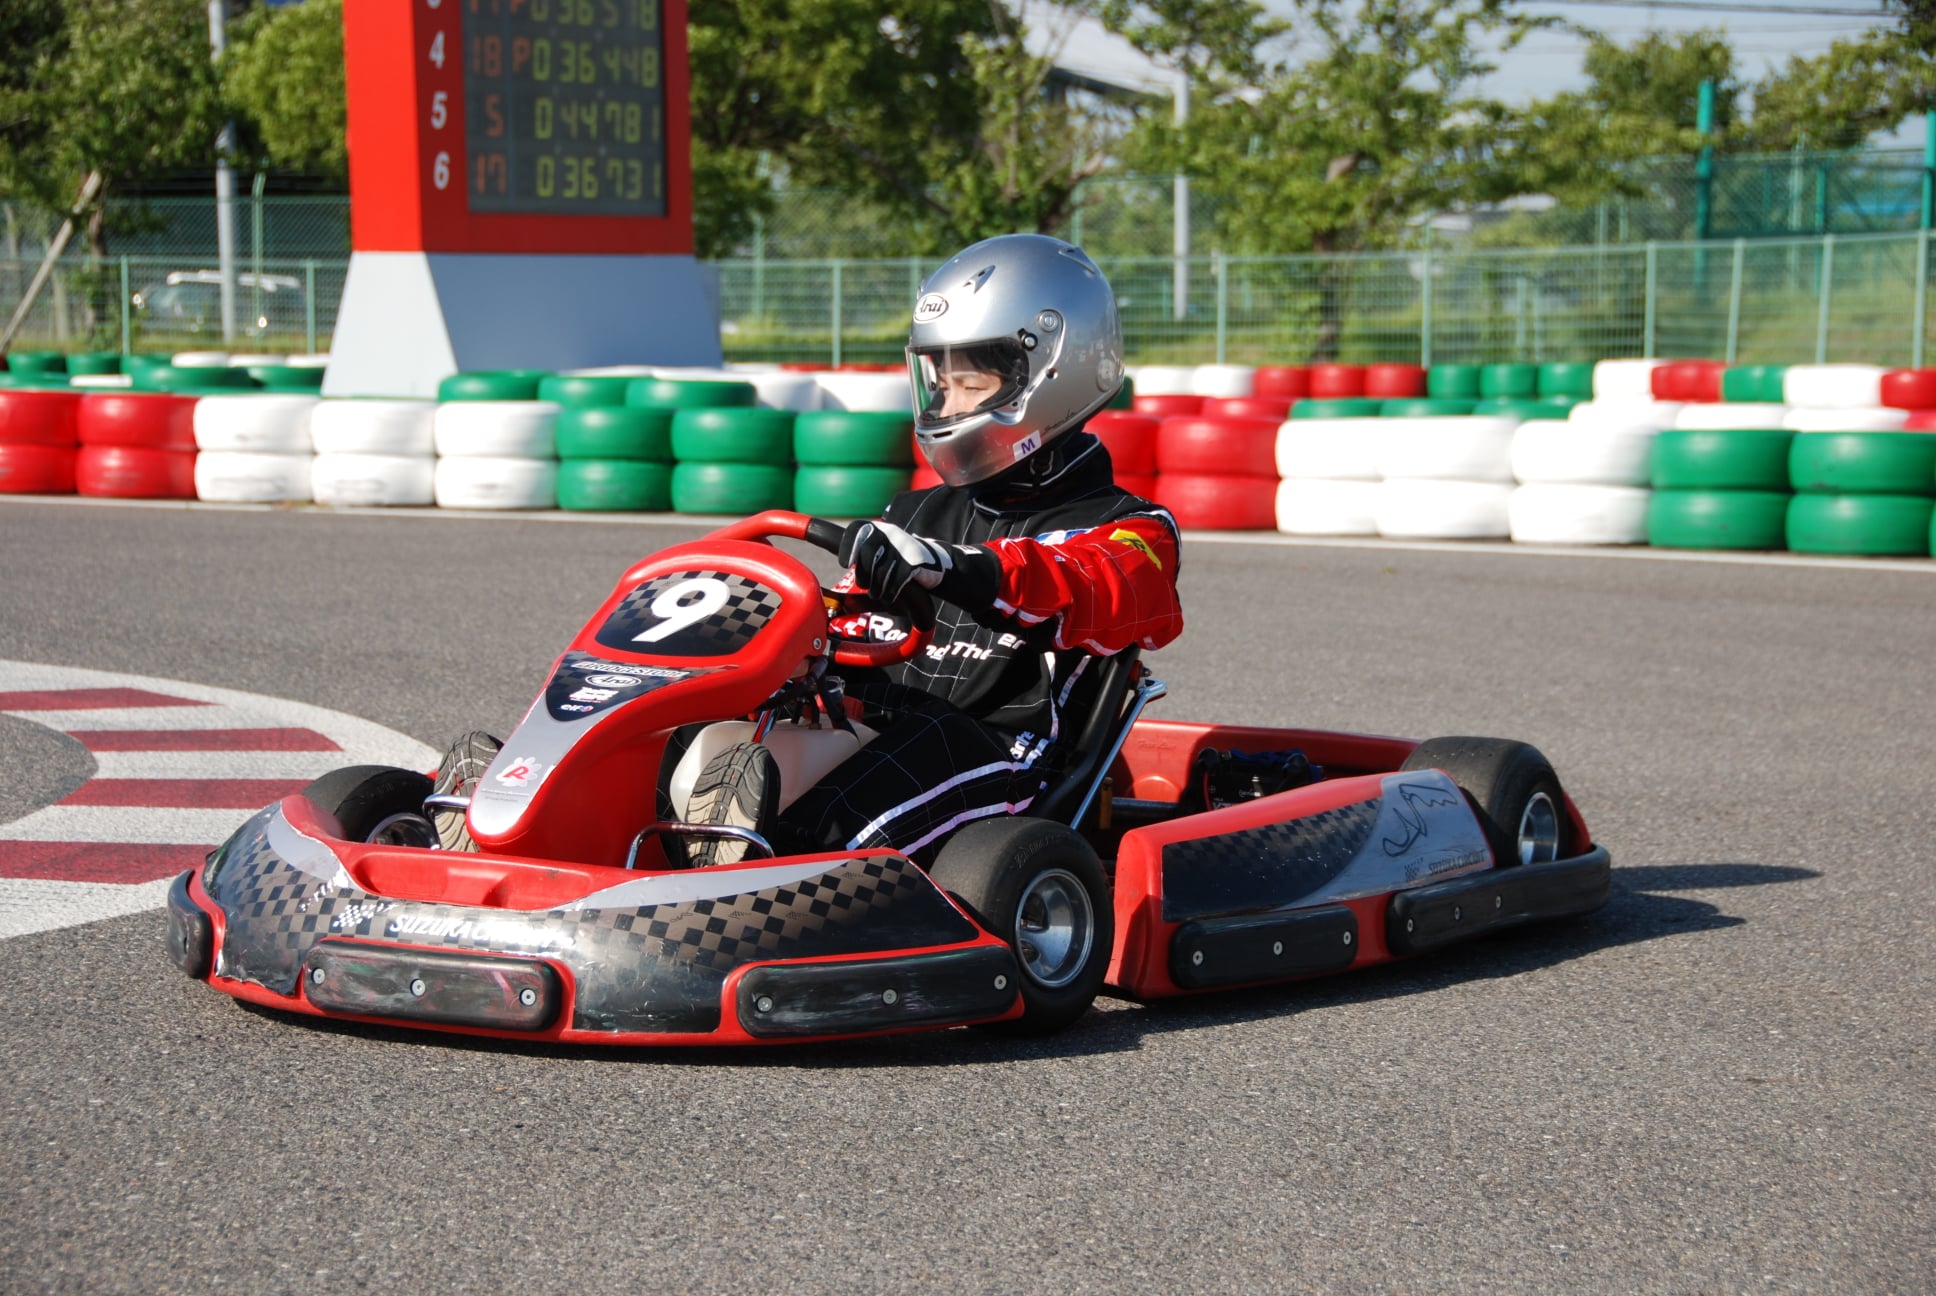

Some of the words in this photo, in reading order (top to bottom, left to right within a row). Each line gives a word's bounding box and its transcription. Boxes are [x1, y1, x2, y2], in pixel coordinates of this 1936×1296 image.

[429, 31, 445, 69] 4
[431, 92, 448, 129] 5
[434, 151, 450, 189] 6
[1021, 438, 1036, 455] M
[631, 578, 730, 643] 9
[390, 914, 472, 939] SUZUKA
